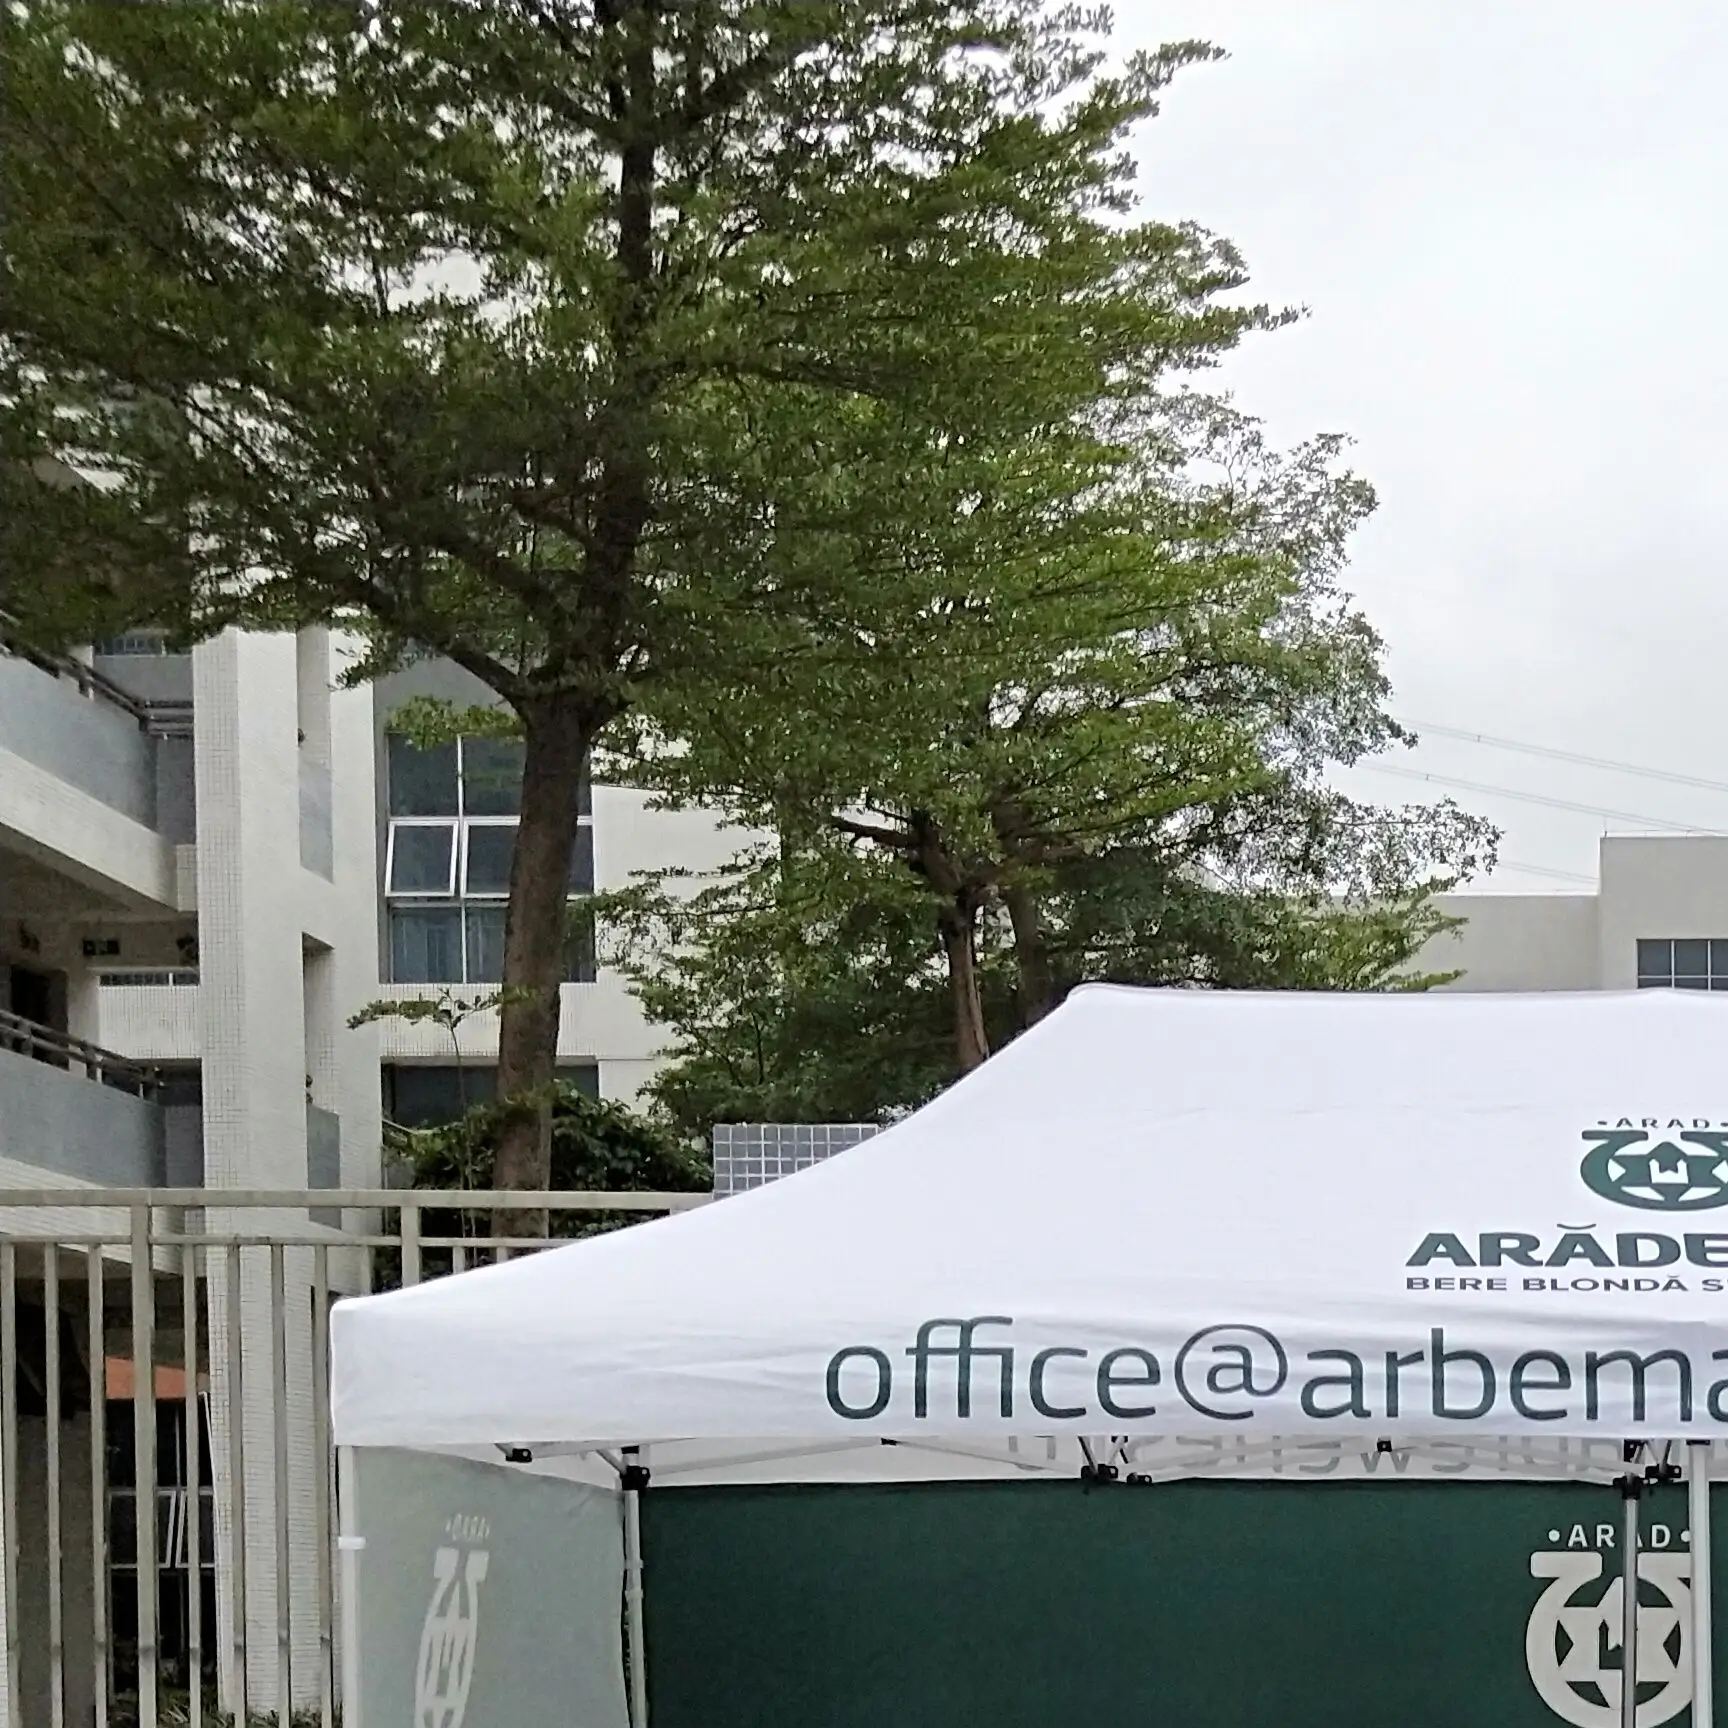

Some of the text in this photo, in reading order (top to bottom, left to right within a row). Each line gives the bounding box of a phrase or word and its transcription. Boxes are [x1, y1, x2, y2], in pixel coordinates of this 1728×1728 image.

[1615, 1116, 1711, 1130] ARAD
[1406, 1276, 1508, 1292] BERE
[1521, 1274, 1689, 1293] BLONDĂ
[1567, 1523, 1671, 1548] ARD
